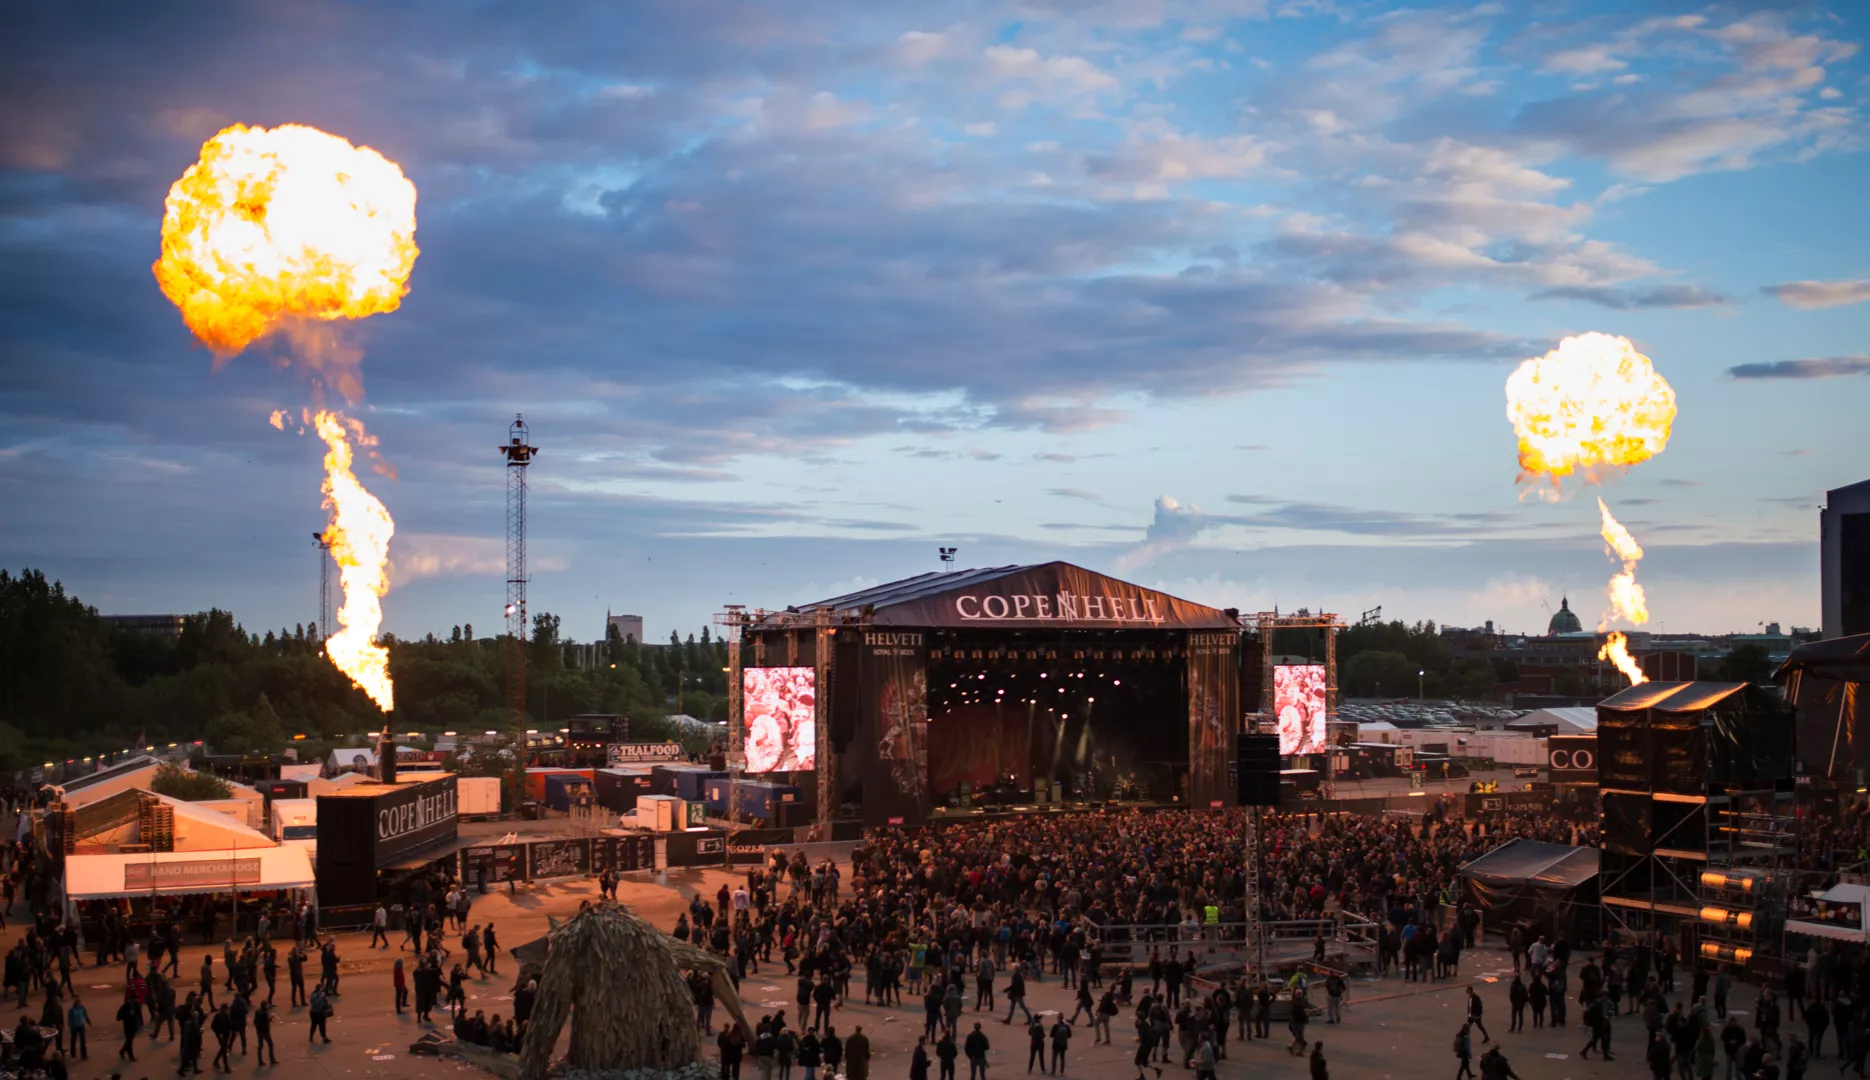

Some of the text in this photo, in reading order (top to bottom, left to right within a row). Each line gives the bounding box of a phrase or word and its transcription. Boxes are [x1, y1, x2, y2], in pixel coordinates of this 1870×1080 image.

[956, 591, 1165, 622] COPENHELL
[865, 633, 923, 646] HELVETI
[1190, 633, 1237, 646] HELVETI
[872, 648, 892, 656] ROYAL
[1550, 749, 1594, 769] CO
[379, 789, 456, 838] COPENHELL
[150, 865, 182, 877] BAND
[183, 861, 260, 875] MERCHANDISE
